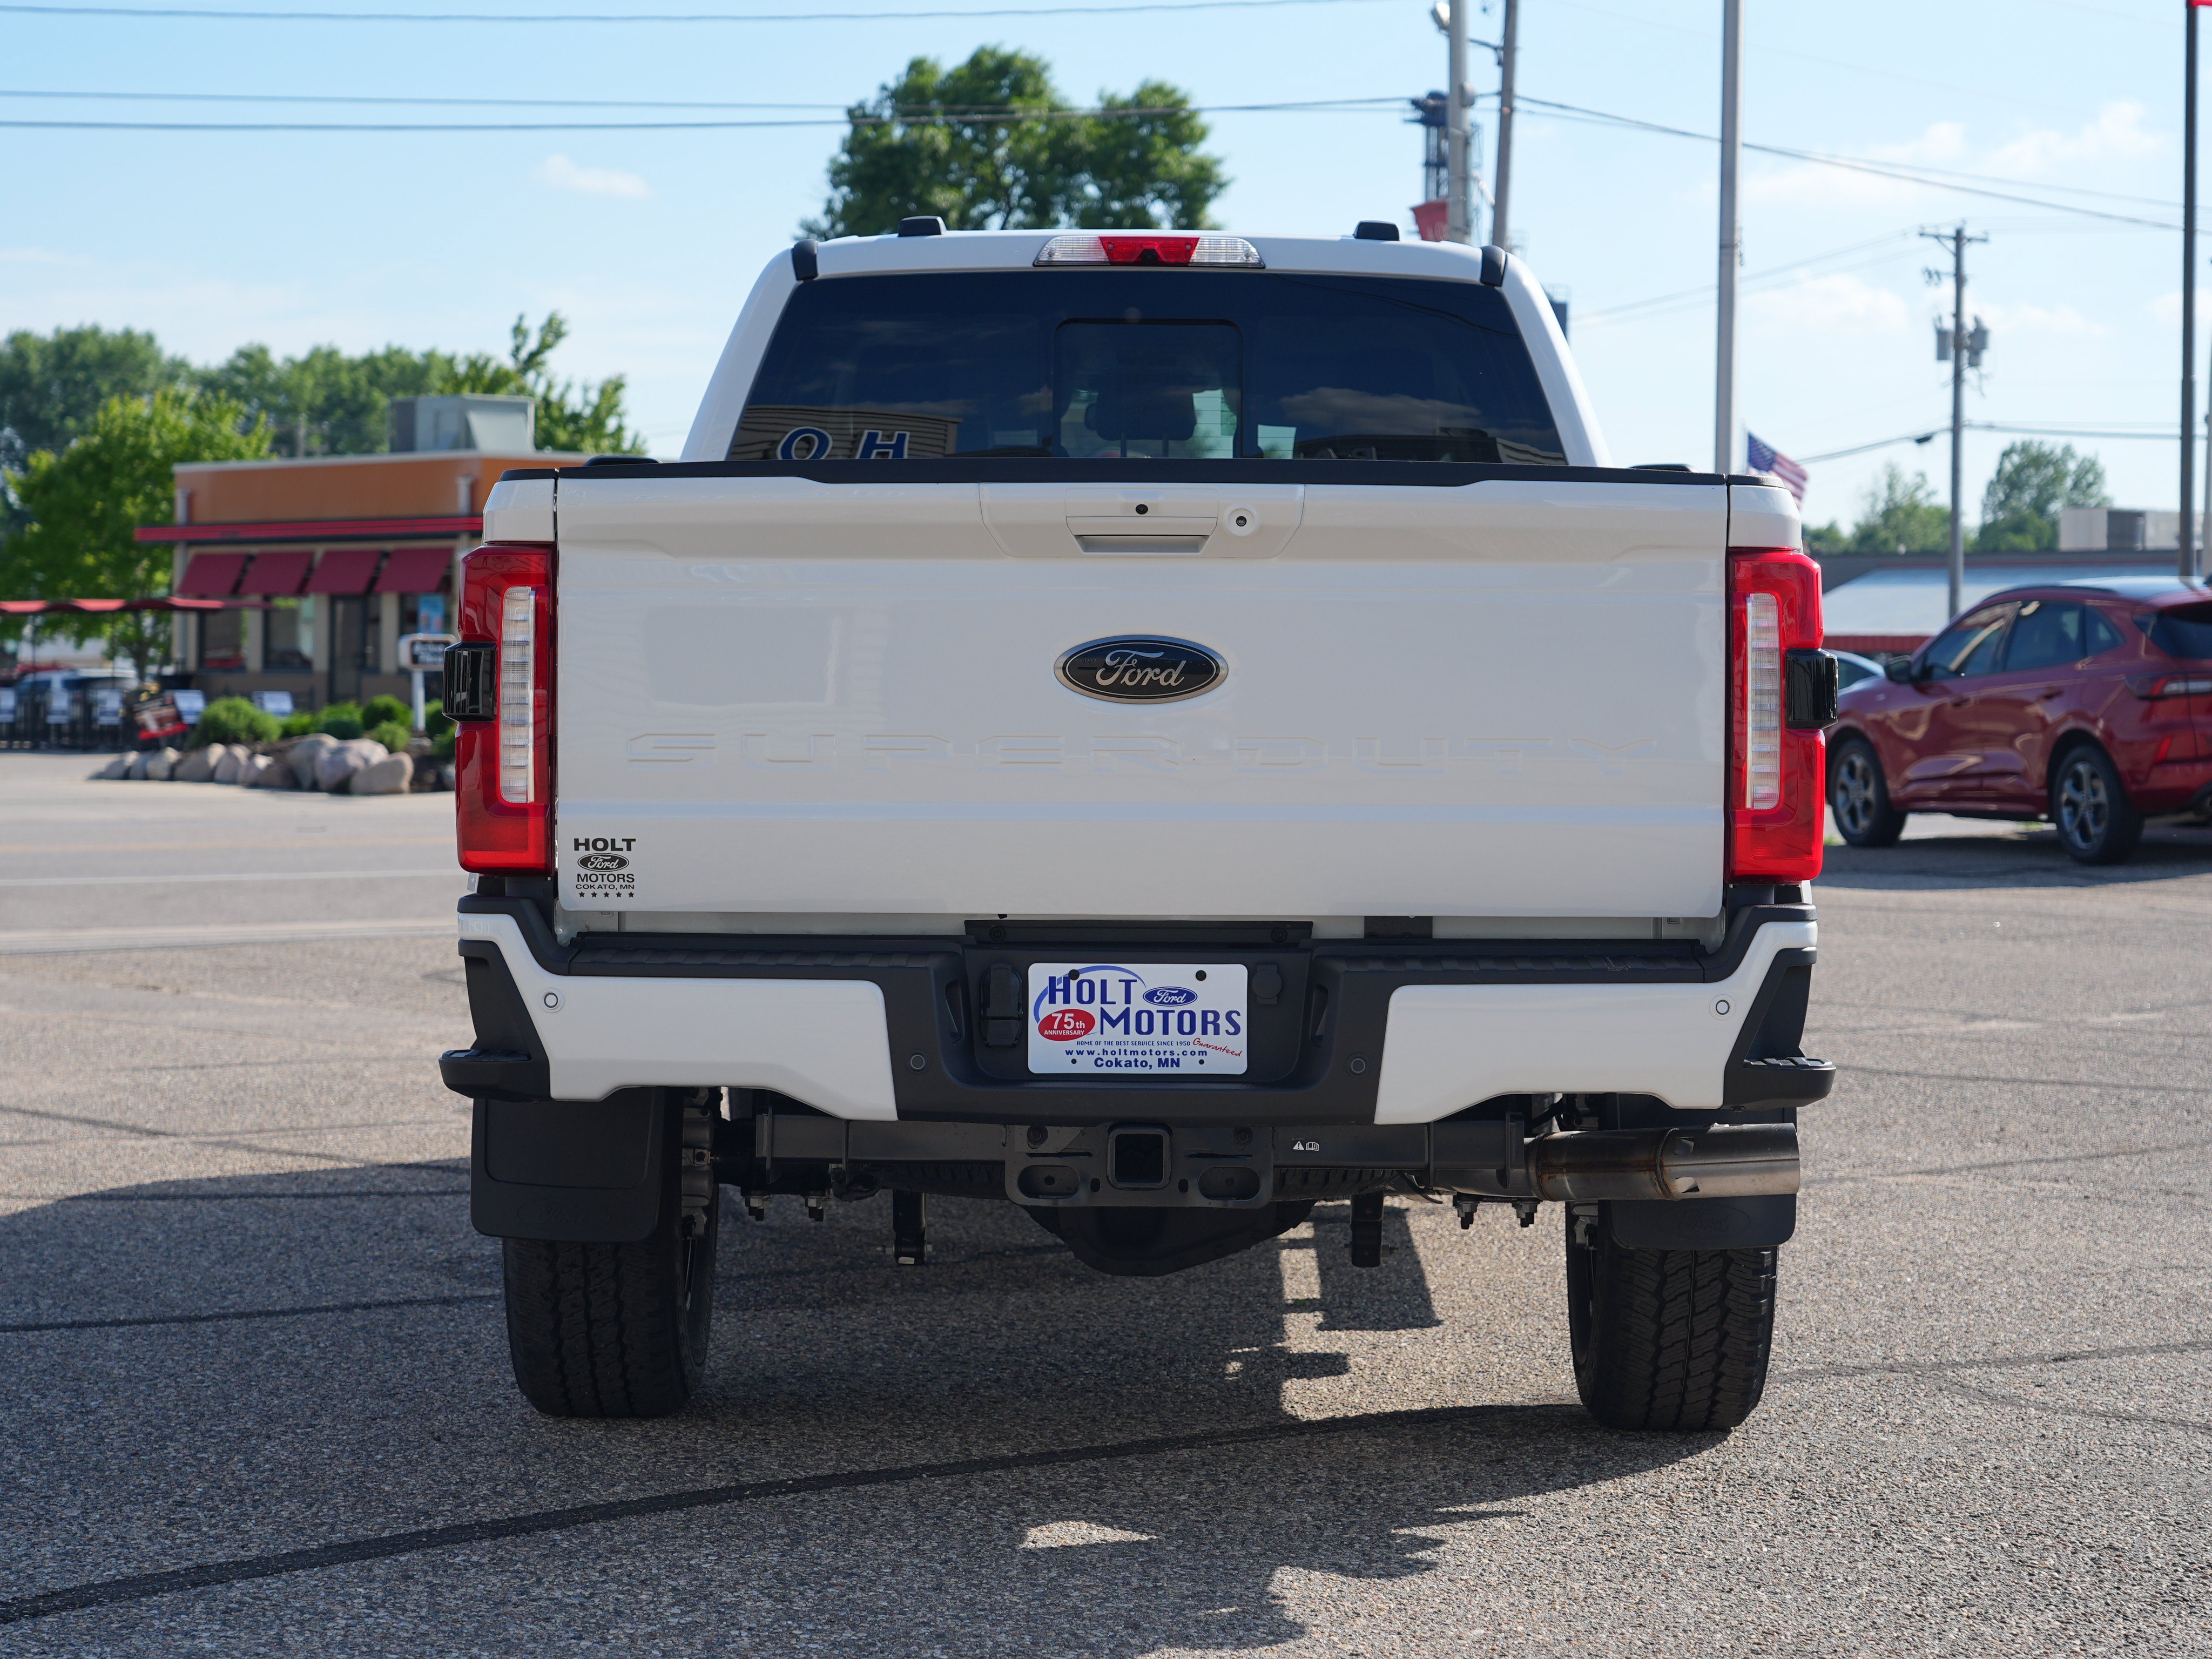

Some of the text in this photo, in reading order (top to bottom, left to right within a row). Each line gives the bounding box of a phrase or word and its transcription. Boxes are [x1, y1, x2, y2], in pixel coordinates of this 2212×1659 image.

[1096, 650, 1186, 686] Ford
[627, 733, 1656, 774] SUPER DUTY
[574, 838, 636, 852] HOLT
[587, 855, 619, 869] Ford
[577, 873, 635, 883] MOTORS
[1048, 976, 1137, 1005] HOLT
[1154, 989, 1187, 1003] Ford
[1051, 1013, 1085, 1030] 75th
[1100, 1007, 1241, 1036] MOTORS
[1065, 1048, 1208, 1056] www.holtmotors.com
[1192, 1037, 1243, 1057] Guaranteed
[1094, 1057, 1180, 1070] Cokato, MN
